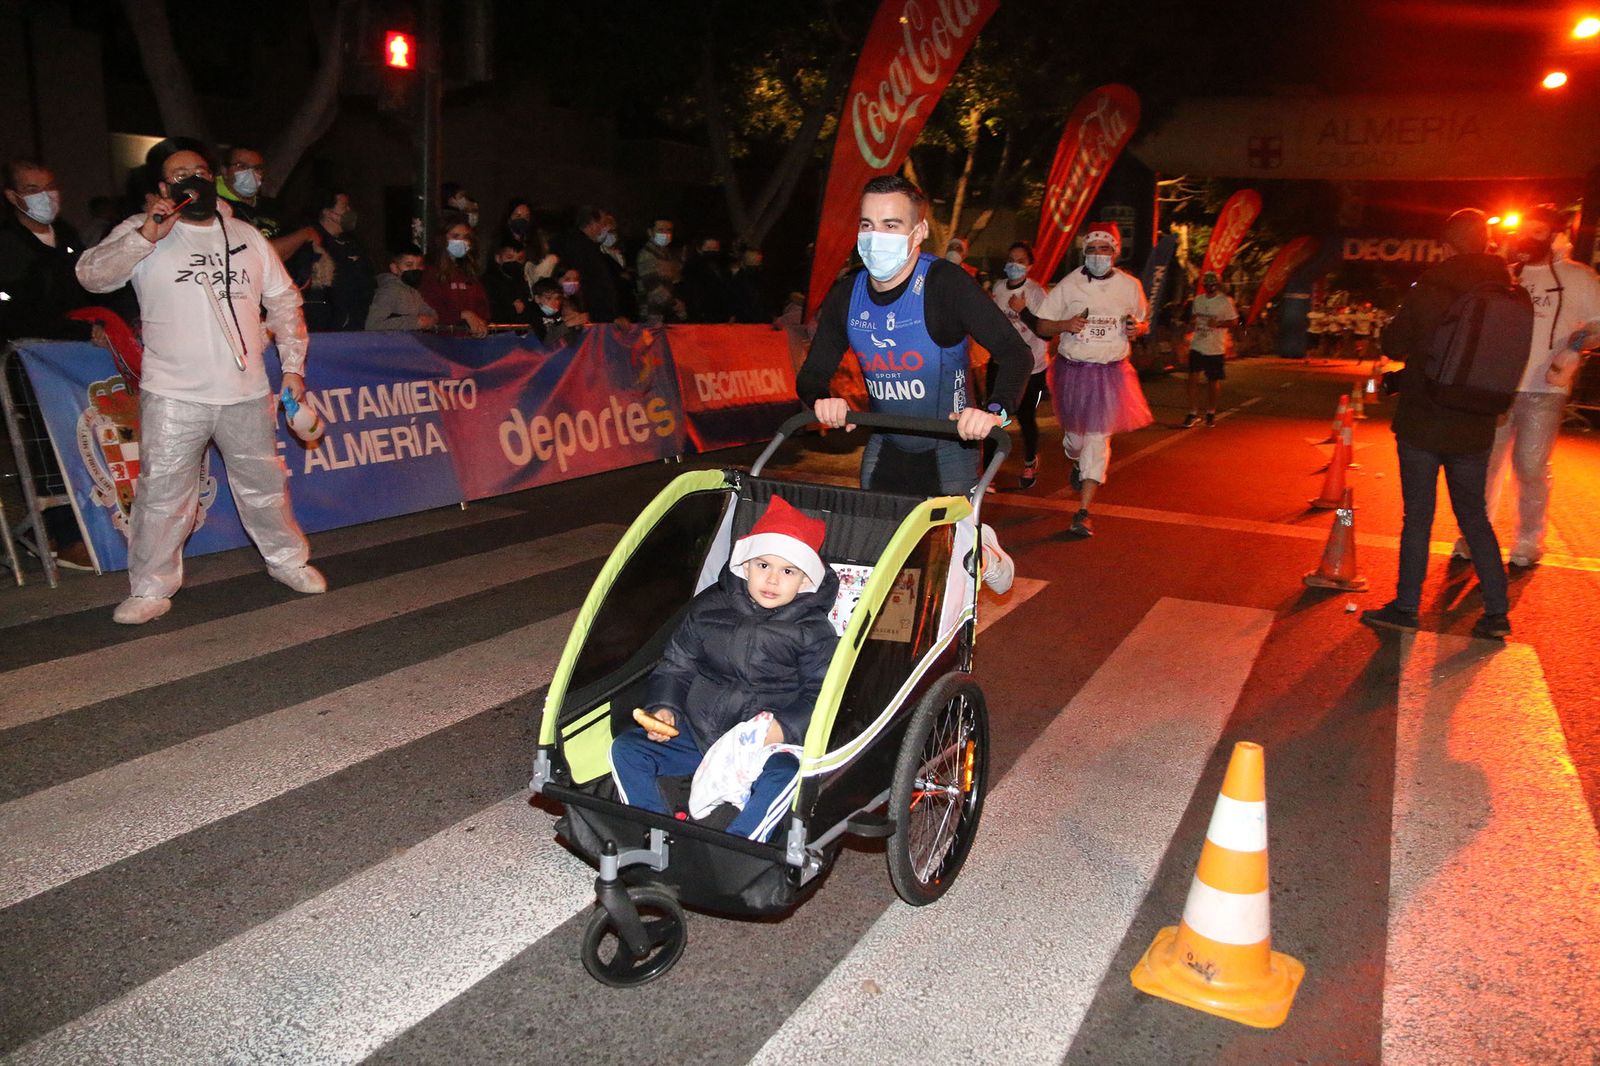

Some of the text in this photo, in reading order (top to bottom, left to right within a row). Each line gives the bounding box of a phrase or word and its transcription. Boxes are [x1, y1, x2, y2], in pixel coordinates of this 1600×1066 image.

[1343, 239, 1444, 262] DECATH
[849, 318, 877, 330] SPIRAL
[1089, 328, 1106, 337] 530
[694, 367, 788, 402] DECATHLON
[275, 378, 477, 429] NTAMIENTO
[304, 417, 449, 475] ALMERÍA
[499, 395, 676, 472] deportes
